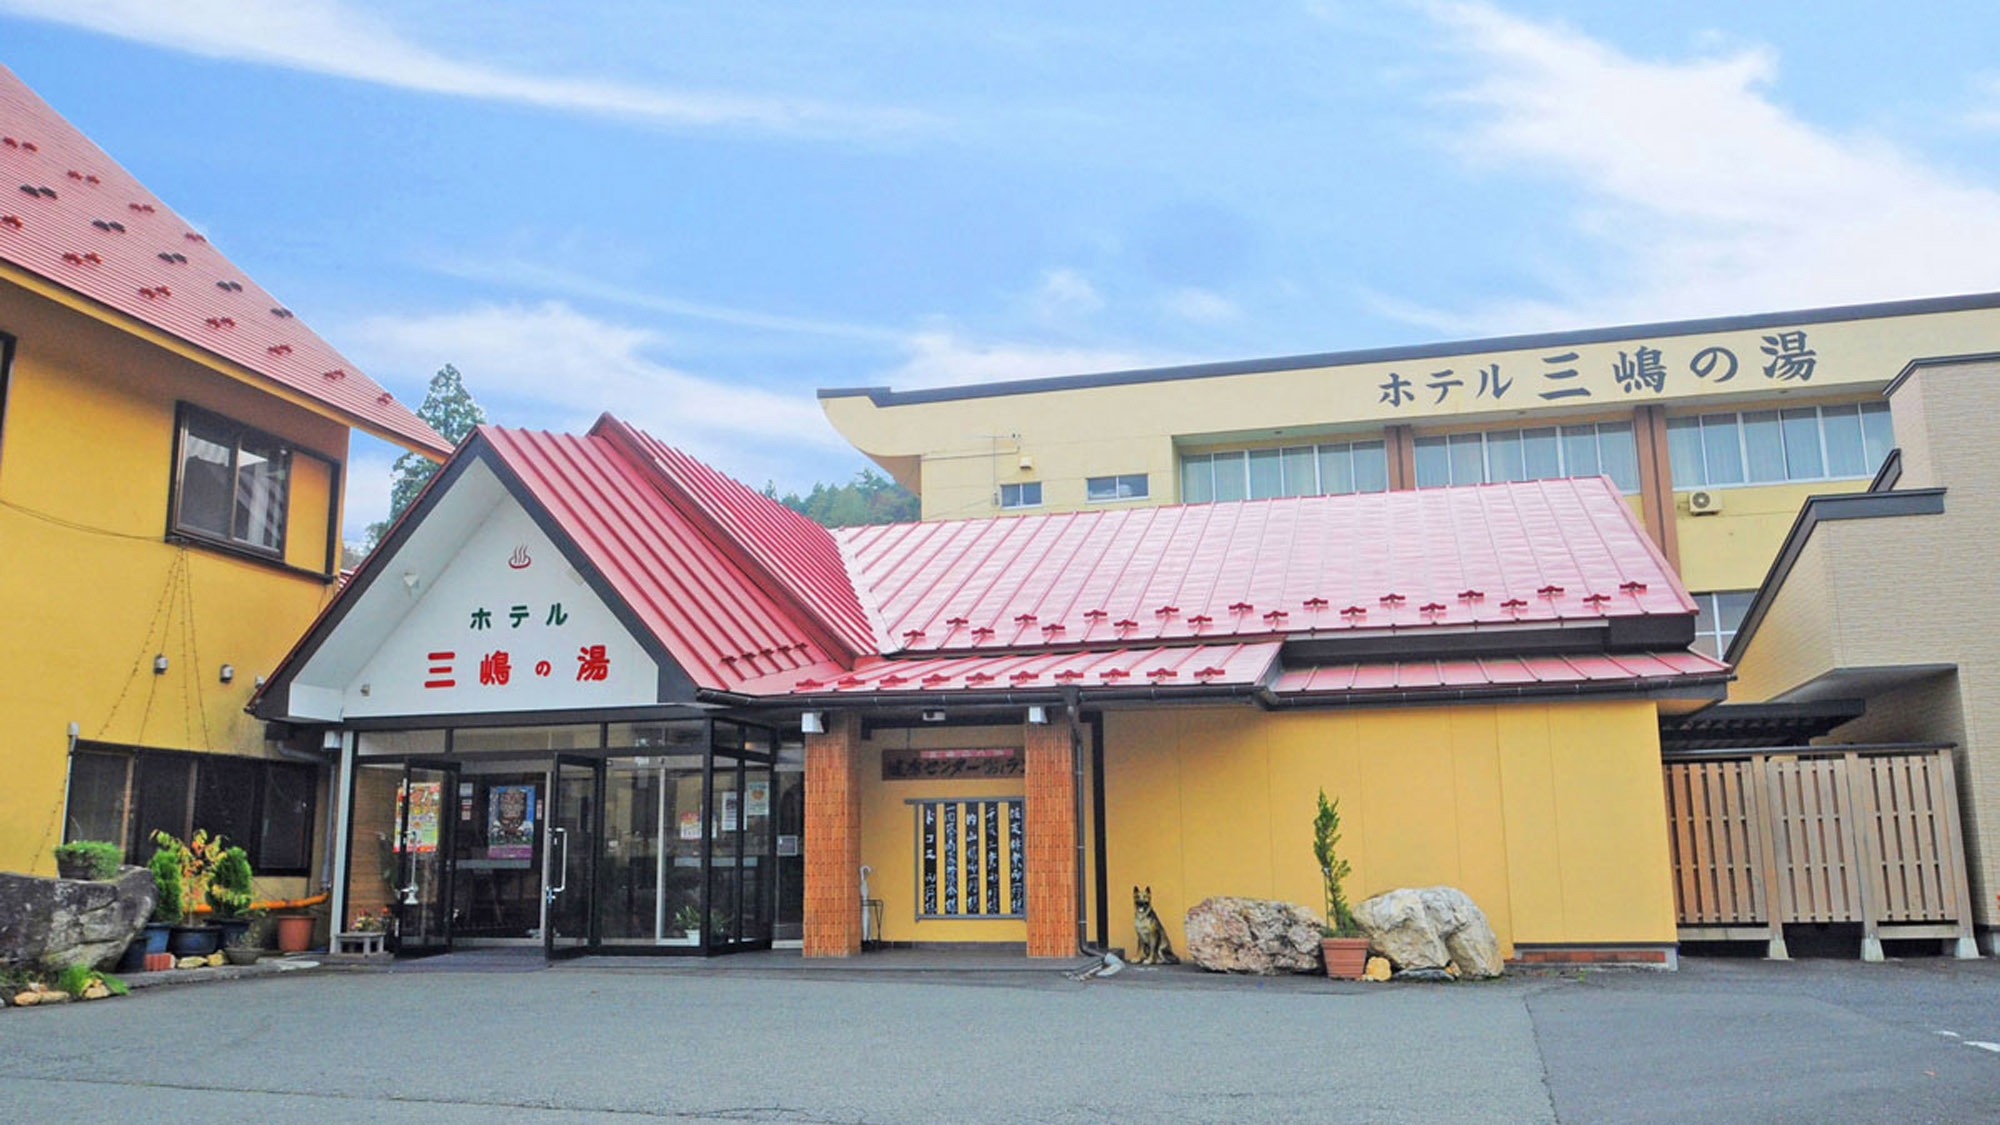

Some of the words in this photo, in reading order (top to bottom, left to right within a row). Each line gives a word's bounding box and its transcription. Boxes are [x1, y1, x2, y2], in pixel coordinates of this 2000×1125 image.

[470, 602, 568, 631] ホテル
[424, 644, 610, 688] 三嶋の湯
